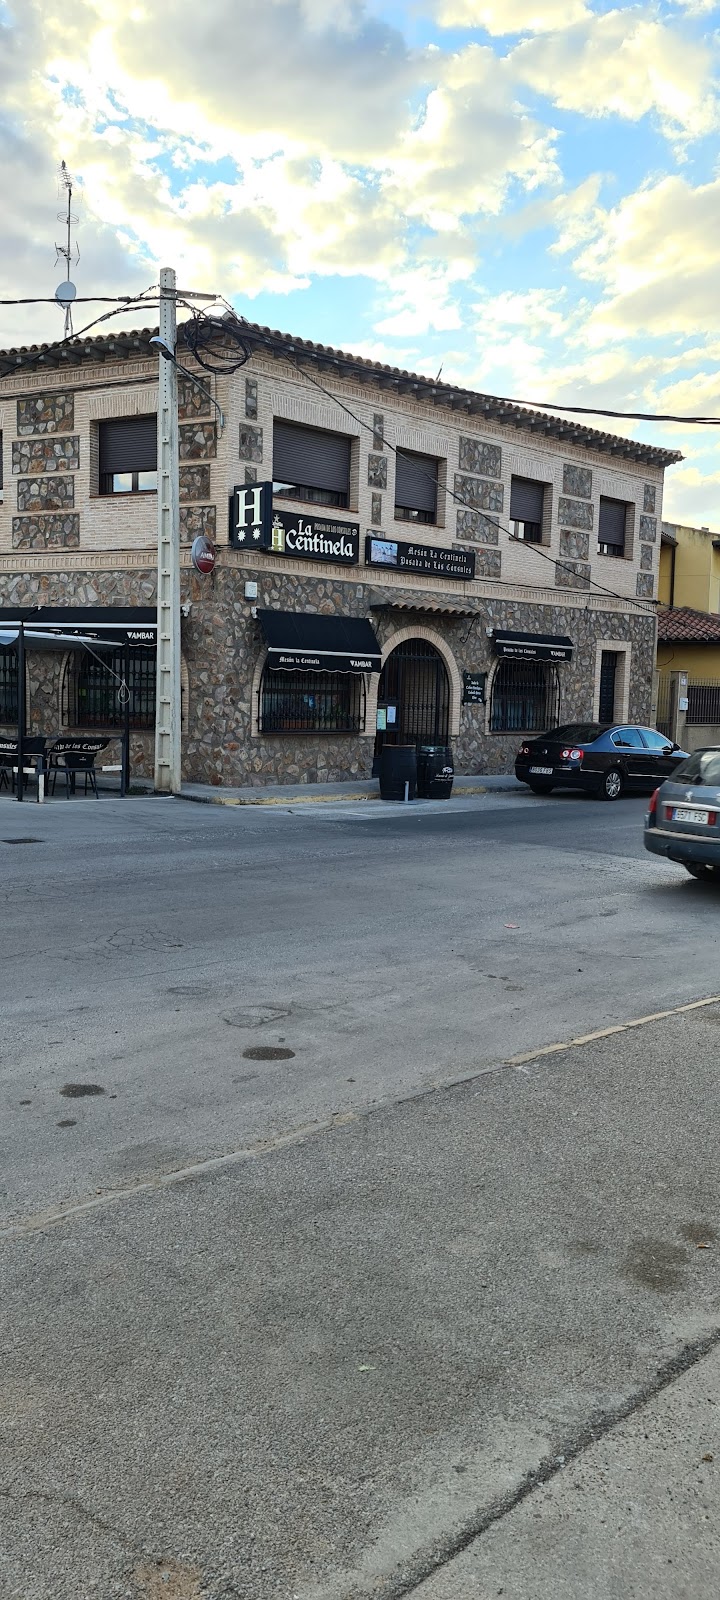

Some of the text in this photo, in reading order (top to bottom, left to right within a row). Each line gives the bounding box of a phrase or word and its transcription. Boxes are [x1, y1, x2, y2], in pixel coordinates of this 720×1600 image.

[236, 487, 262, 528] H
[298, 519, 313, 537] La
[286, 529, 355, 558] Centinela
[400, 556, 422, 567] Posada
[424, 560, 431, 569] de
[430, 549, 438, 559] La
[439, 551, 467, 564] Centinela
